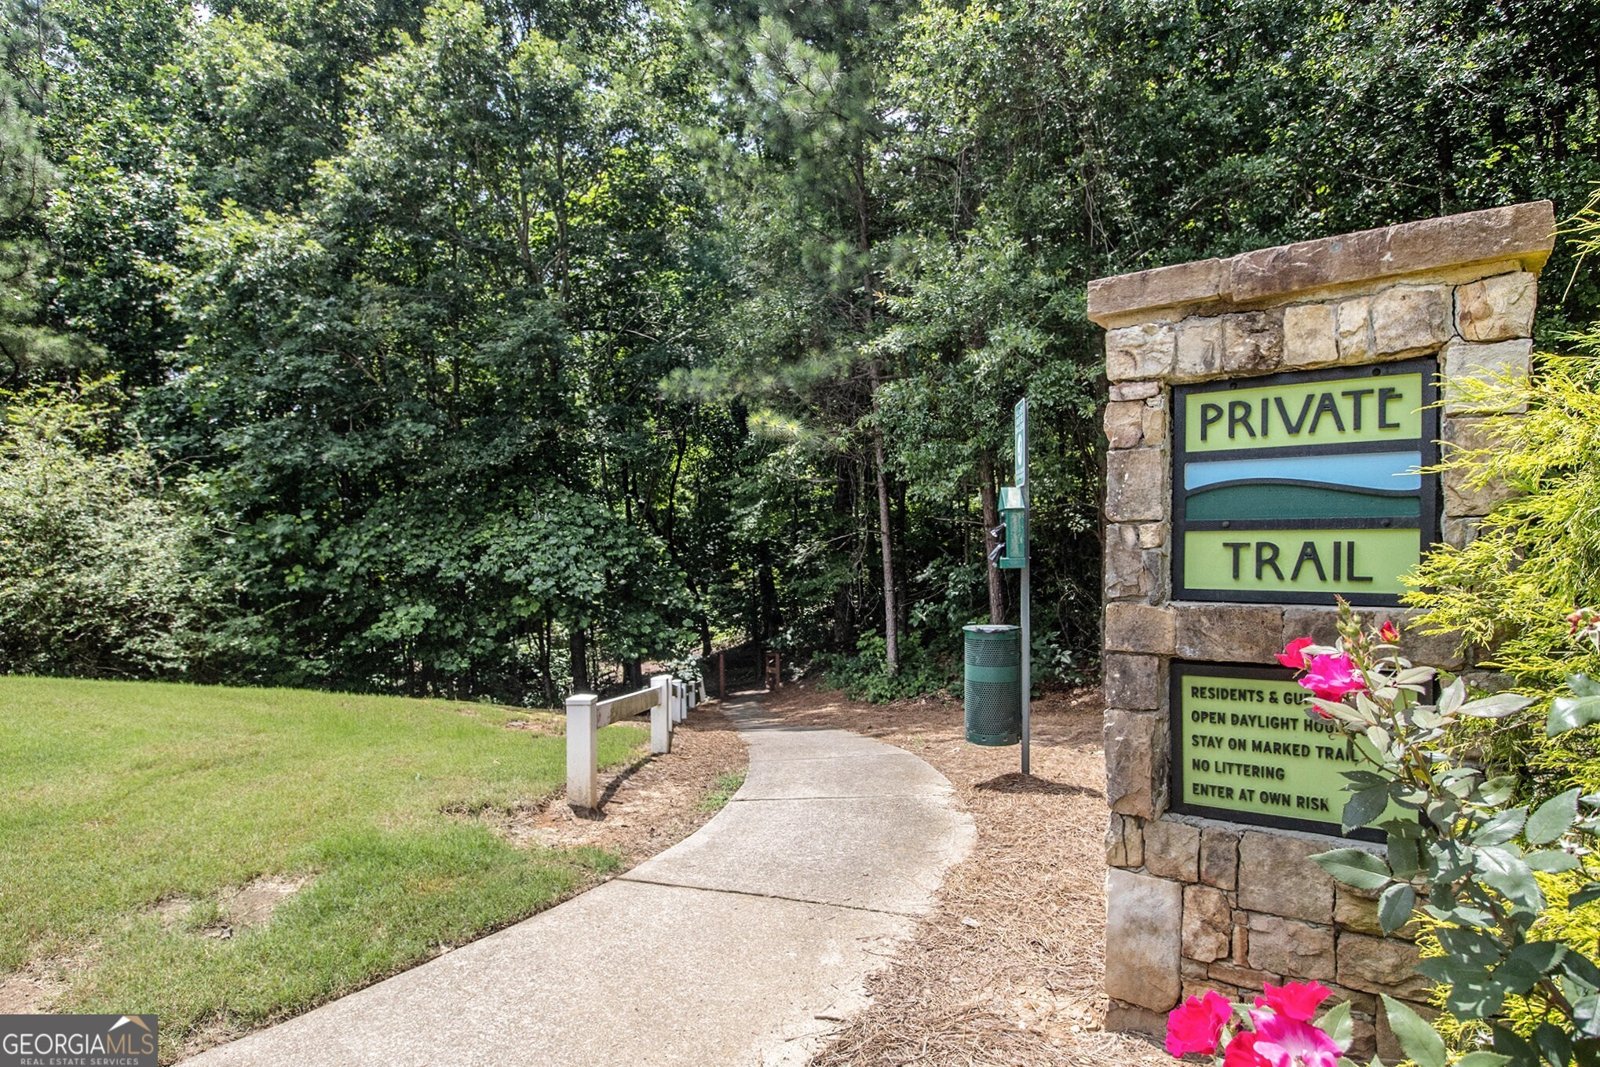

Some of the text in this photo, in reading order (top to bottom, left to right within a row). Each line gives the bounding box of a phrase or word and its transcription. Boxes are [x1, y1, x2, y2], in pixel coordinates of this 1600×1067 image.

[1200, 386, 1403, 441] PRIVATE
[1222, 541, 1373, 582] TRAIL
[1191, 686, 1264, 704] RESIDENTS
[1268, 691, 1279, 704] &
[1191, 710, 1226, 725] OPEN
[1231, 714, 1299, 731] DAYLIGHT
[1191, 735, 1223, 749] STAY
[1228, 738, 1247, 751] ON
[1251, 740, 1310, 758] MARKED
[1192, 758, 1285, 780] NO LITTERING
[1192, 783, 1329, 812] ENTER AT OWN RISK
